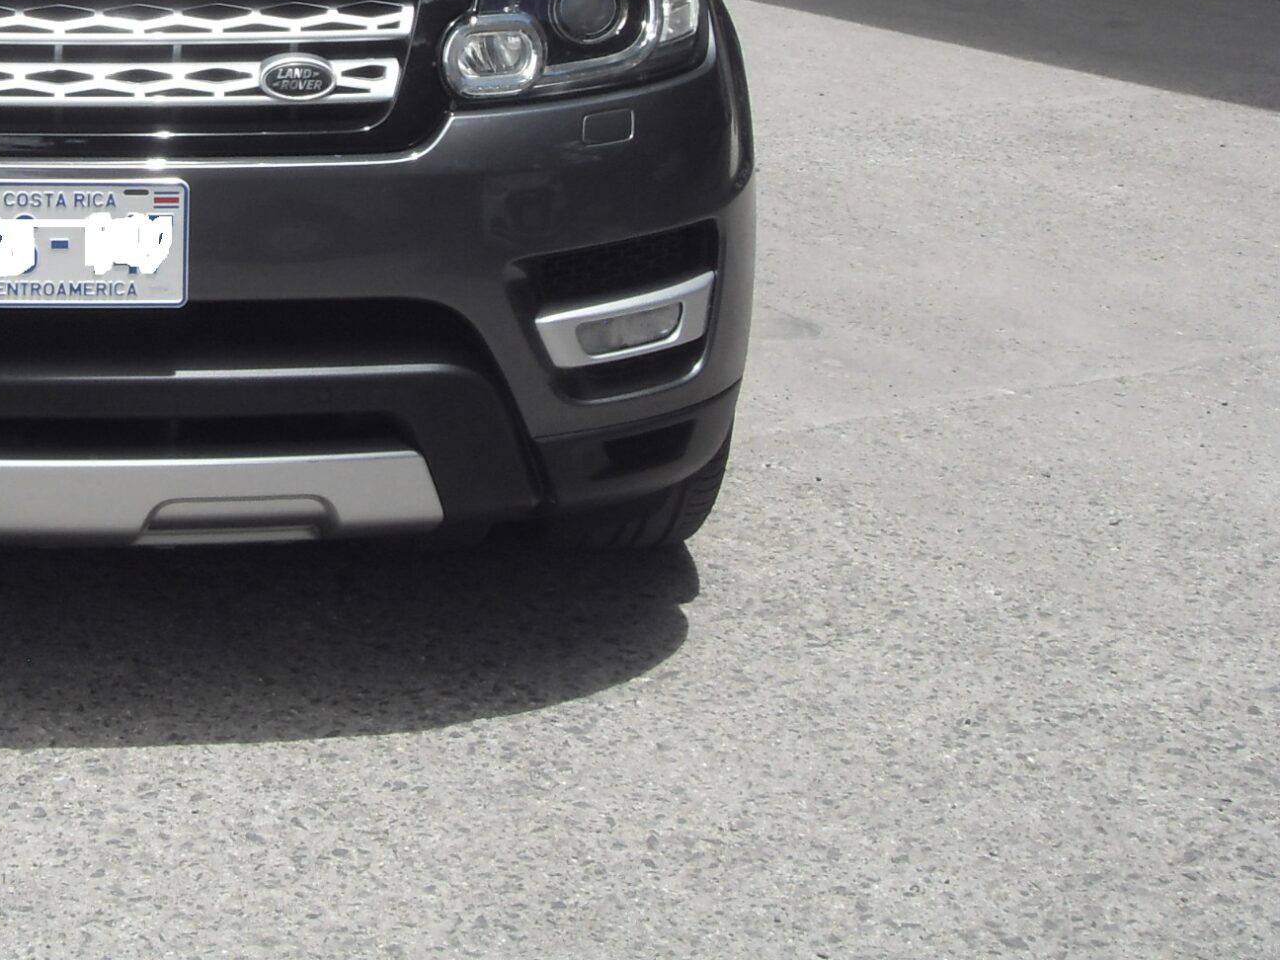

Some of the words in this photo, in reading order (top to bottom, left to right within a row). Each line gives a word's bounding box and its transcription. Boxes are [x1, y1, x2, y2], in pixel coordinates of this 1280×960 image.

[277, 68, 312, 79] LAND
[280, 79, 322, 90] ROVER
[3, 192, 66, 208] COSTA
[74, 192, 116, 208] RICA
